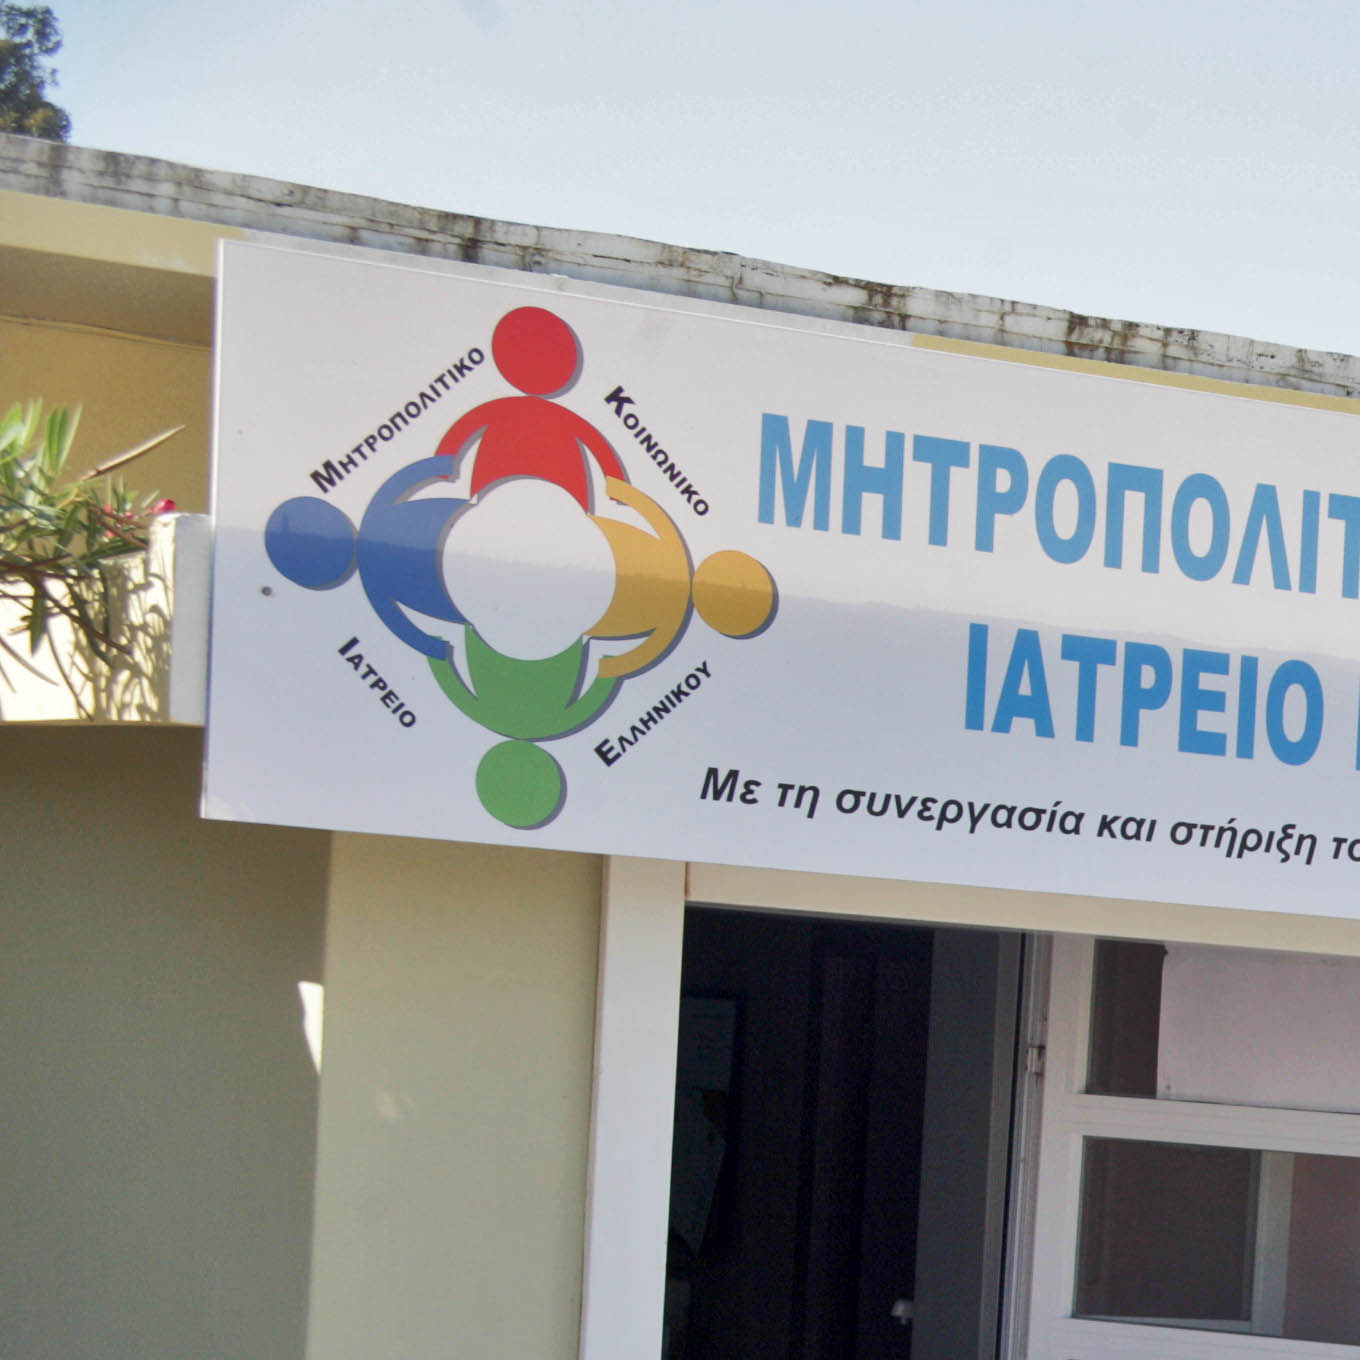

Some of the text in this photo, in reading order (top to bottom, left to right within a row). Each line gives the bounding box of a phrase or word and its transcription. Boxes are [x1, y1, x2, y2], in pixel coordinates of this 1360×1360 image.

[963, 622, 1326, 768] ΙΑΤΡΕΙΟ
[698, 765, 763, 806] Με
[776, 781, 821, 820] τη
[834, 789, 1086, 839] συνεργασία
[1095, 813, 1158, 843] και
[1169, 816, 1319, 867] στήριξη
